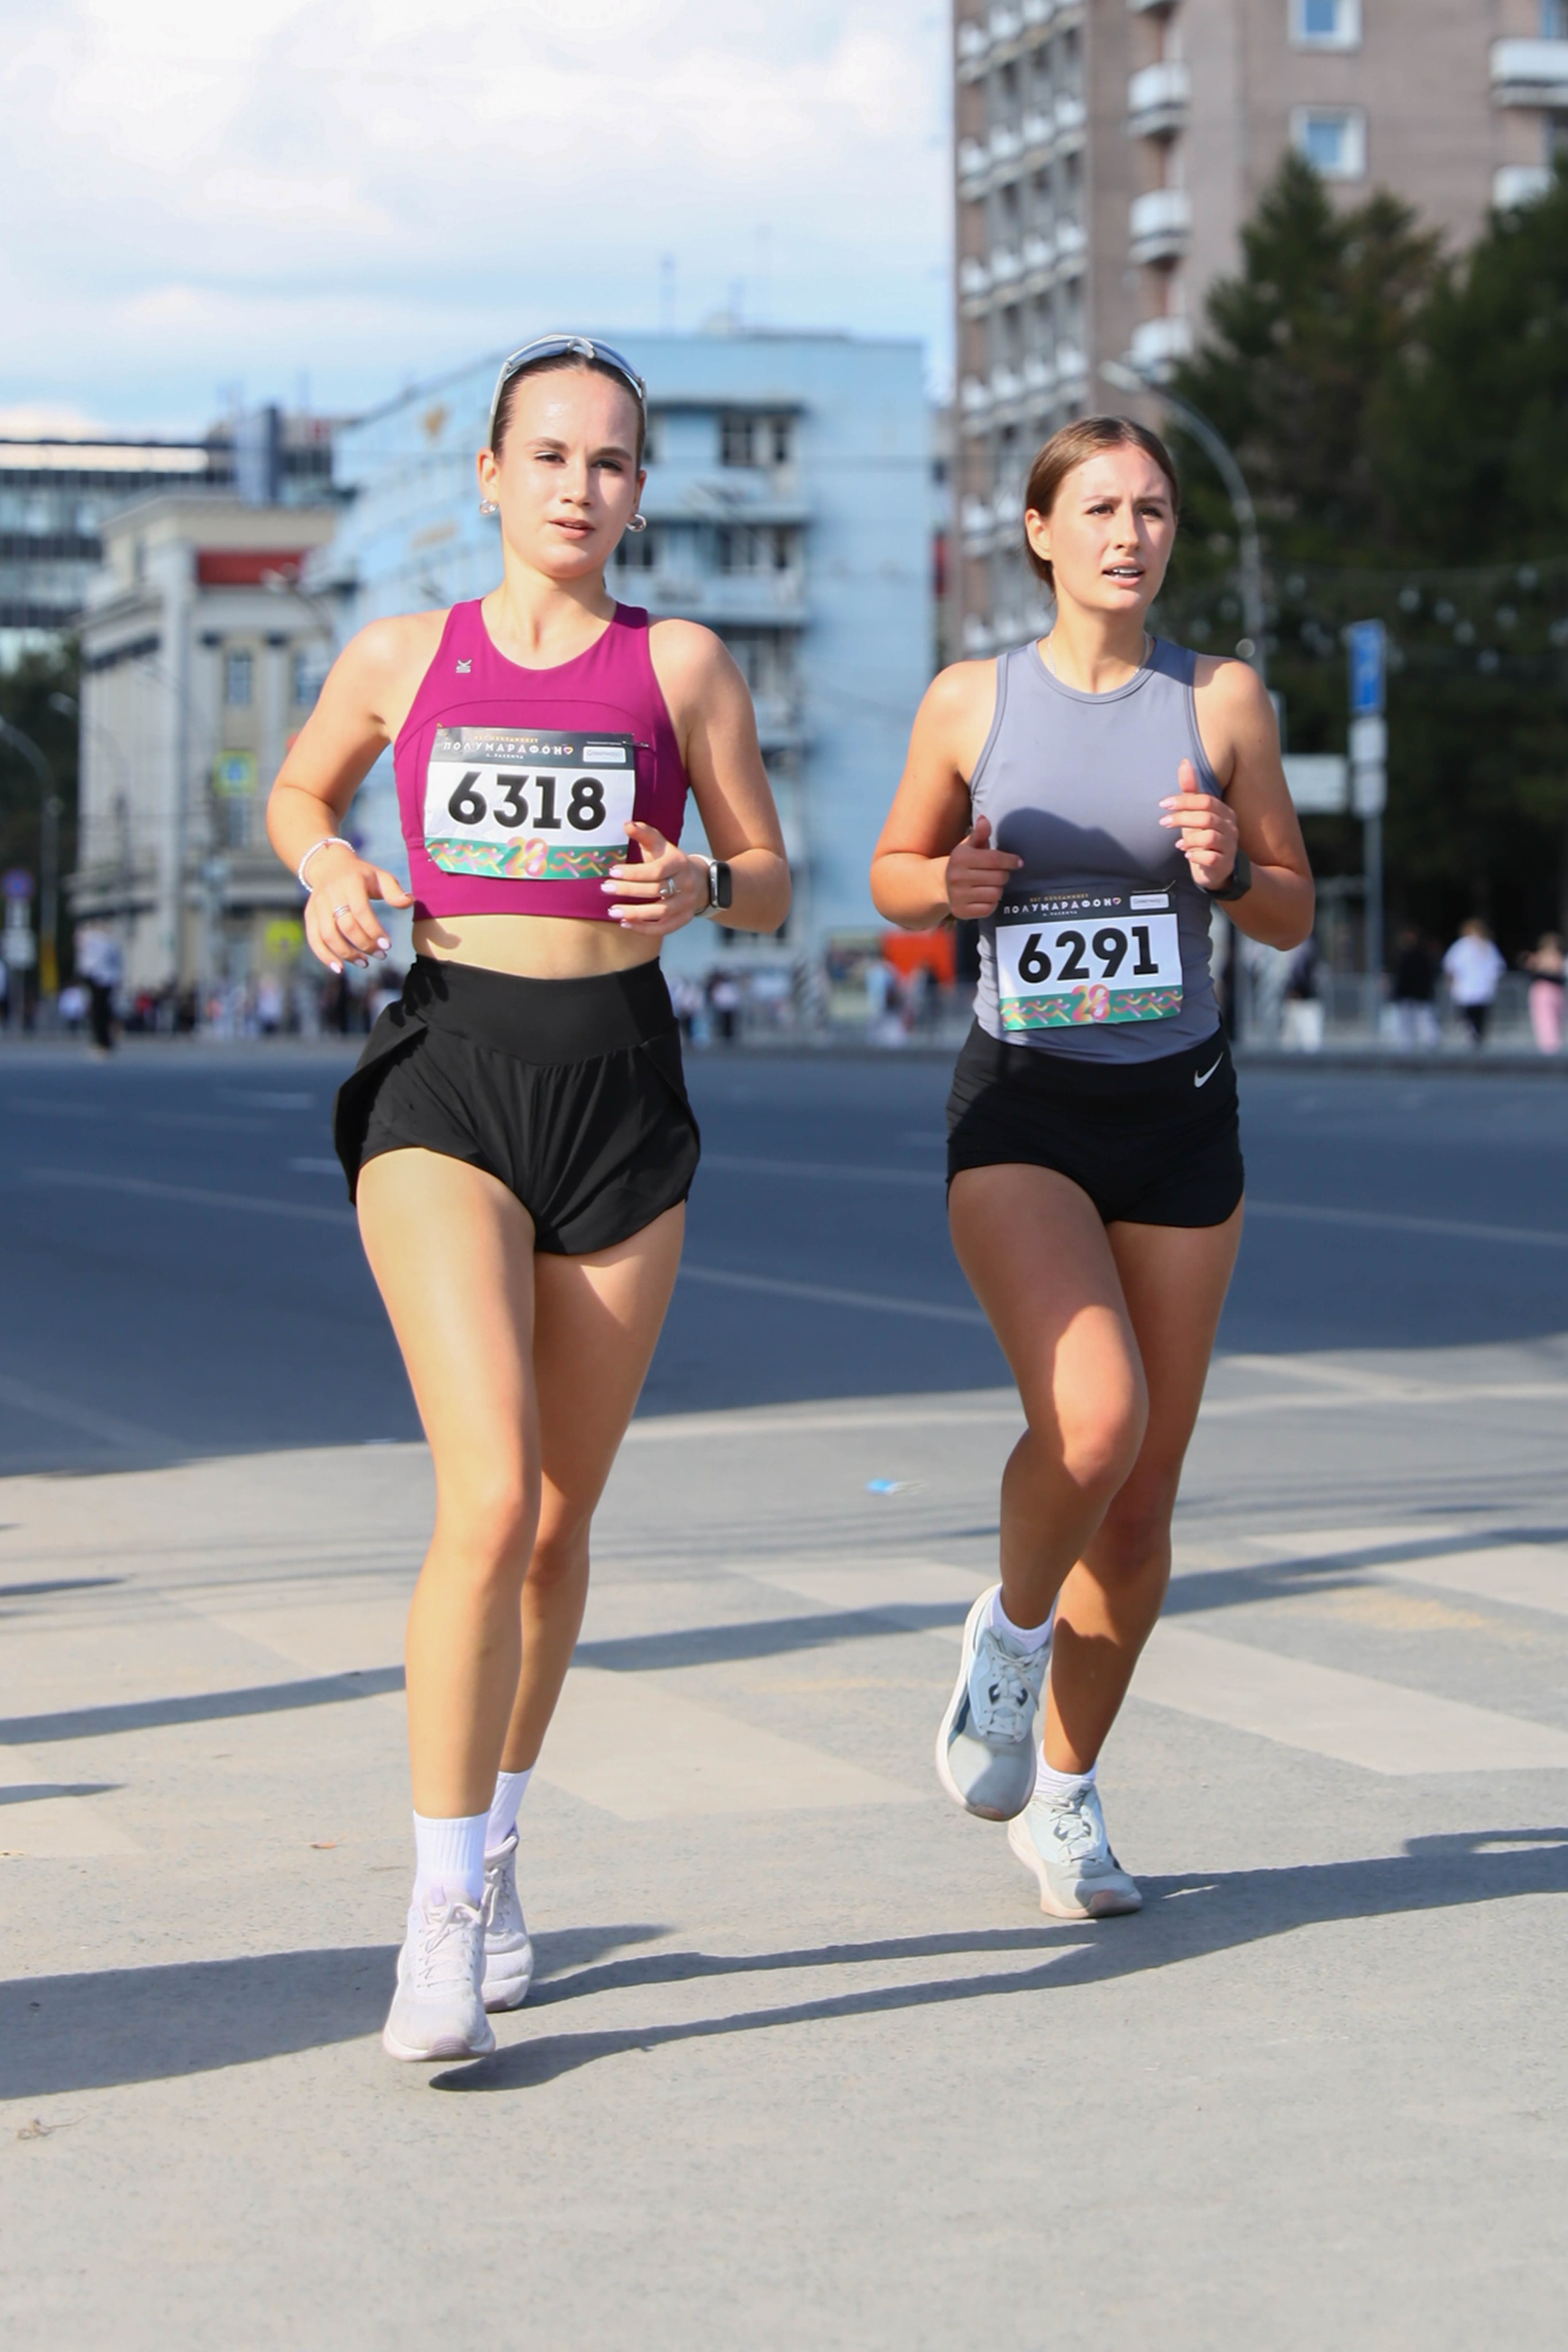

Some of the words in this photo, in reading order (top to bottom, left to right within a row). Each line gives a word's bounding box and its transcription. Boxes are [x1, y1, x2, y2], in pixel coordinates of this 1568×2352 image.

[443, 741, 562, 756] ПОЛУМАРАФОН
[448, 771, 606, 831] 6318
[1004, 897, 1112, 914] ПОЛУМАРАФОН
[1018, 925, 1159, 984] 6291
